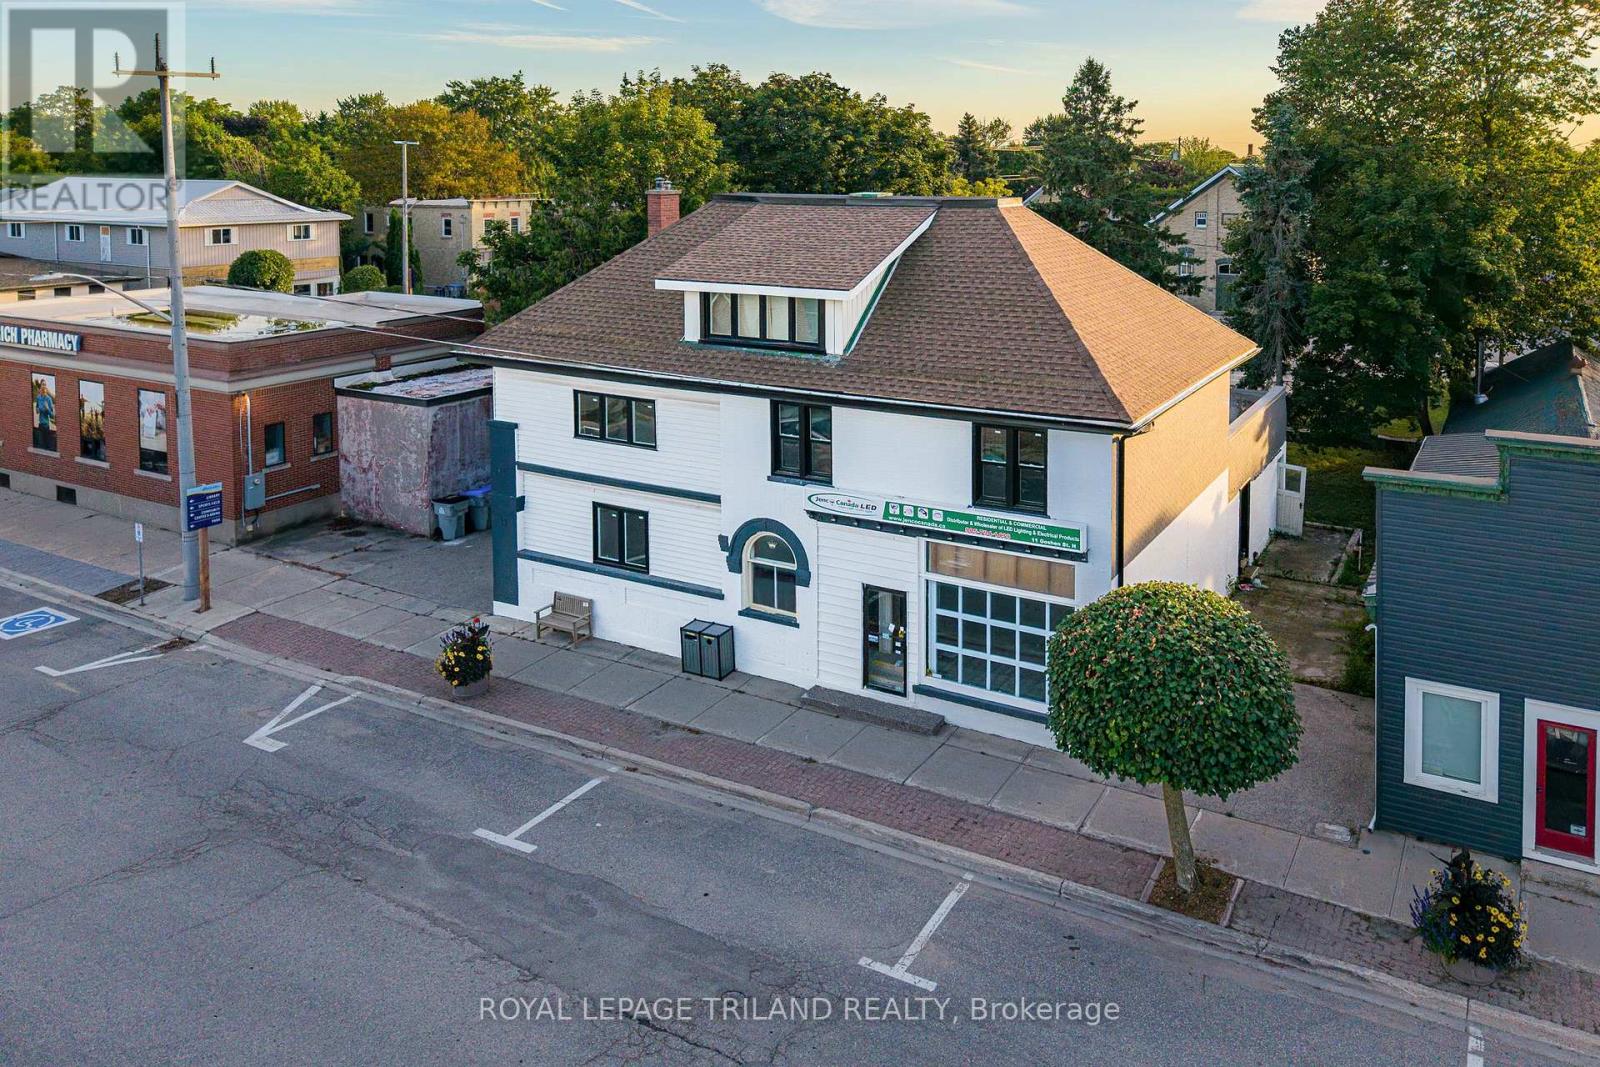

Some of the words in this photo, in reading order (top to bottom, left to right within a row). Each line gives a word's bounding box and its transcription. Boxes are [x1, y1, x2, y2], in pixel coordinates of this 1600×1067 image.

[21, 327, 78, 351] PHARMACY
[836, 499, 859, 508] Canada
[860, 503, 877, 511] LED
[946, 516, 969, 526] Distributor
[974, 521, 998, 530] Wholesaler
[1003, 525, 1013, 533] LED
[1014, 527, 1032, 536] Lighting
[1037, 530, 1059, 539] Electrical
[1059, 533, 1080, 542] Products
[976, 515, 1007, 525] RESIDENTIAL
[1013, 520, 1046, 530] COMMERCIAL
[1040, 539, 1061, 547] Goshen
